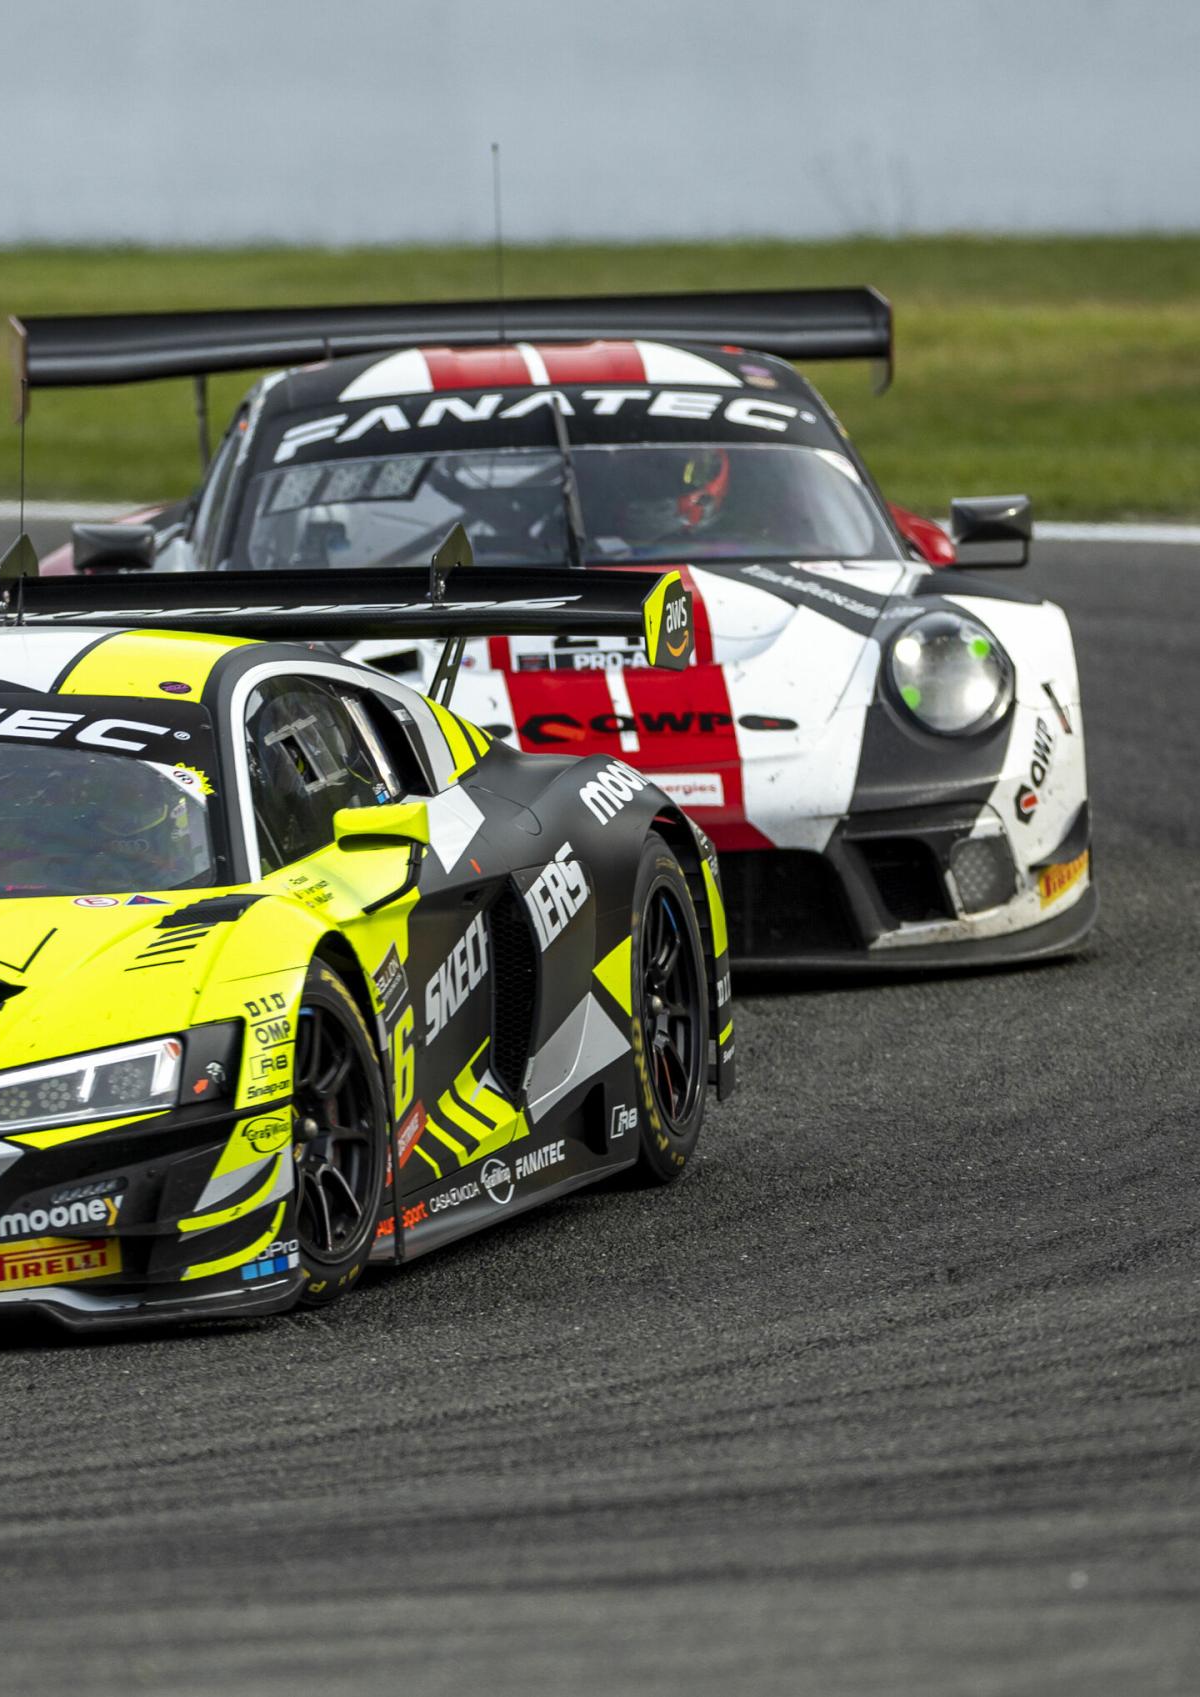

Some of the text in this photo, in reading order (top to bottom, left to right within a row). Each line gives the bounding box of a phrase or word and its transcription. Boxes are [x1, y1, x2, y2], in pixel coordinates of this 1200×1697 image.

[666, 596, 688, 634] aws
[574, 651, 649, 671] PRO-A
[245, 992, 287, 1017] DID
[255, 1020, 291, 1044] OMP
[260, 1054, 289, 1074] R8
[388, 1005, 414, 1122] 6
[247, 1080, 290, 1099] Snap-on
[617, 1107, 638, 1133] R8
[515, 1139, 566, 1180] FANATEC
